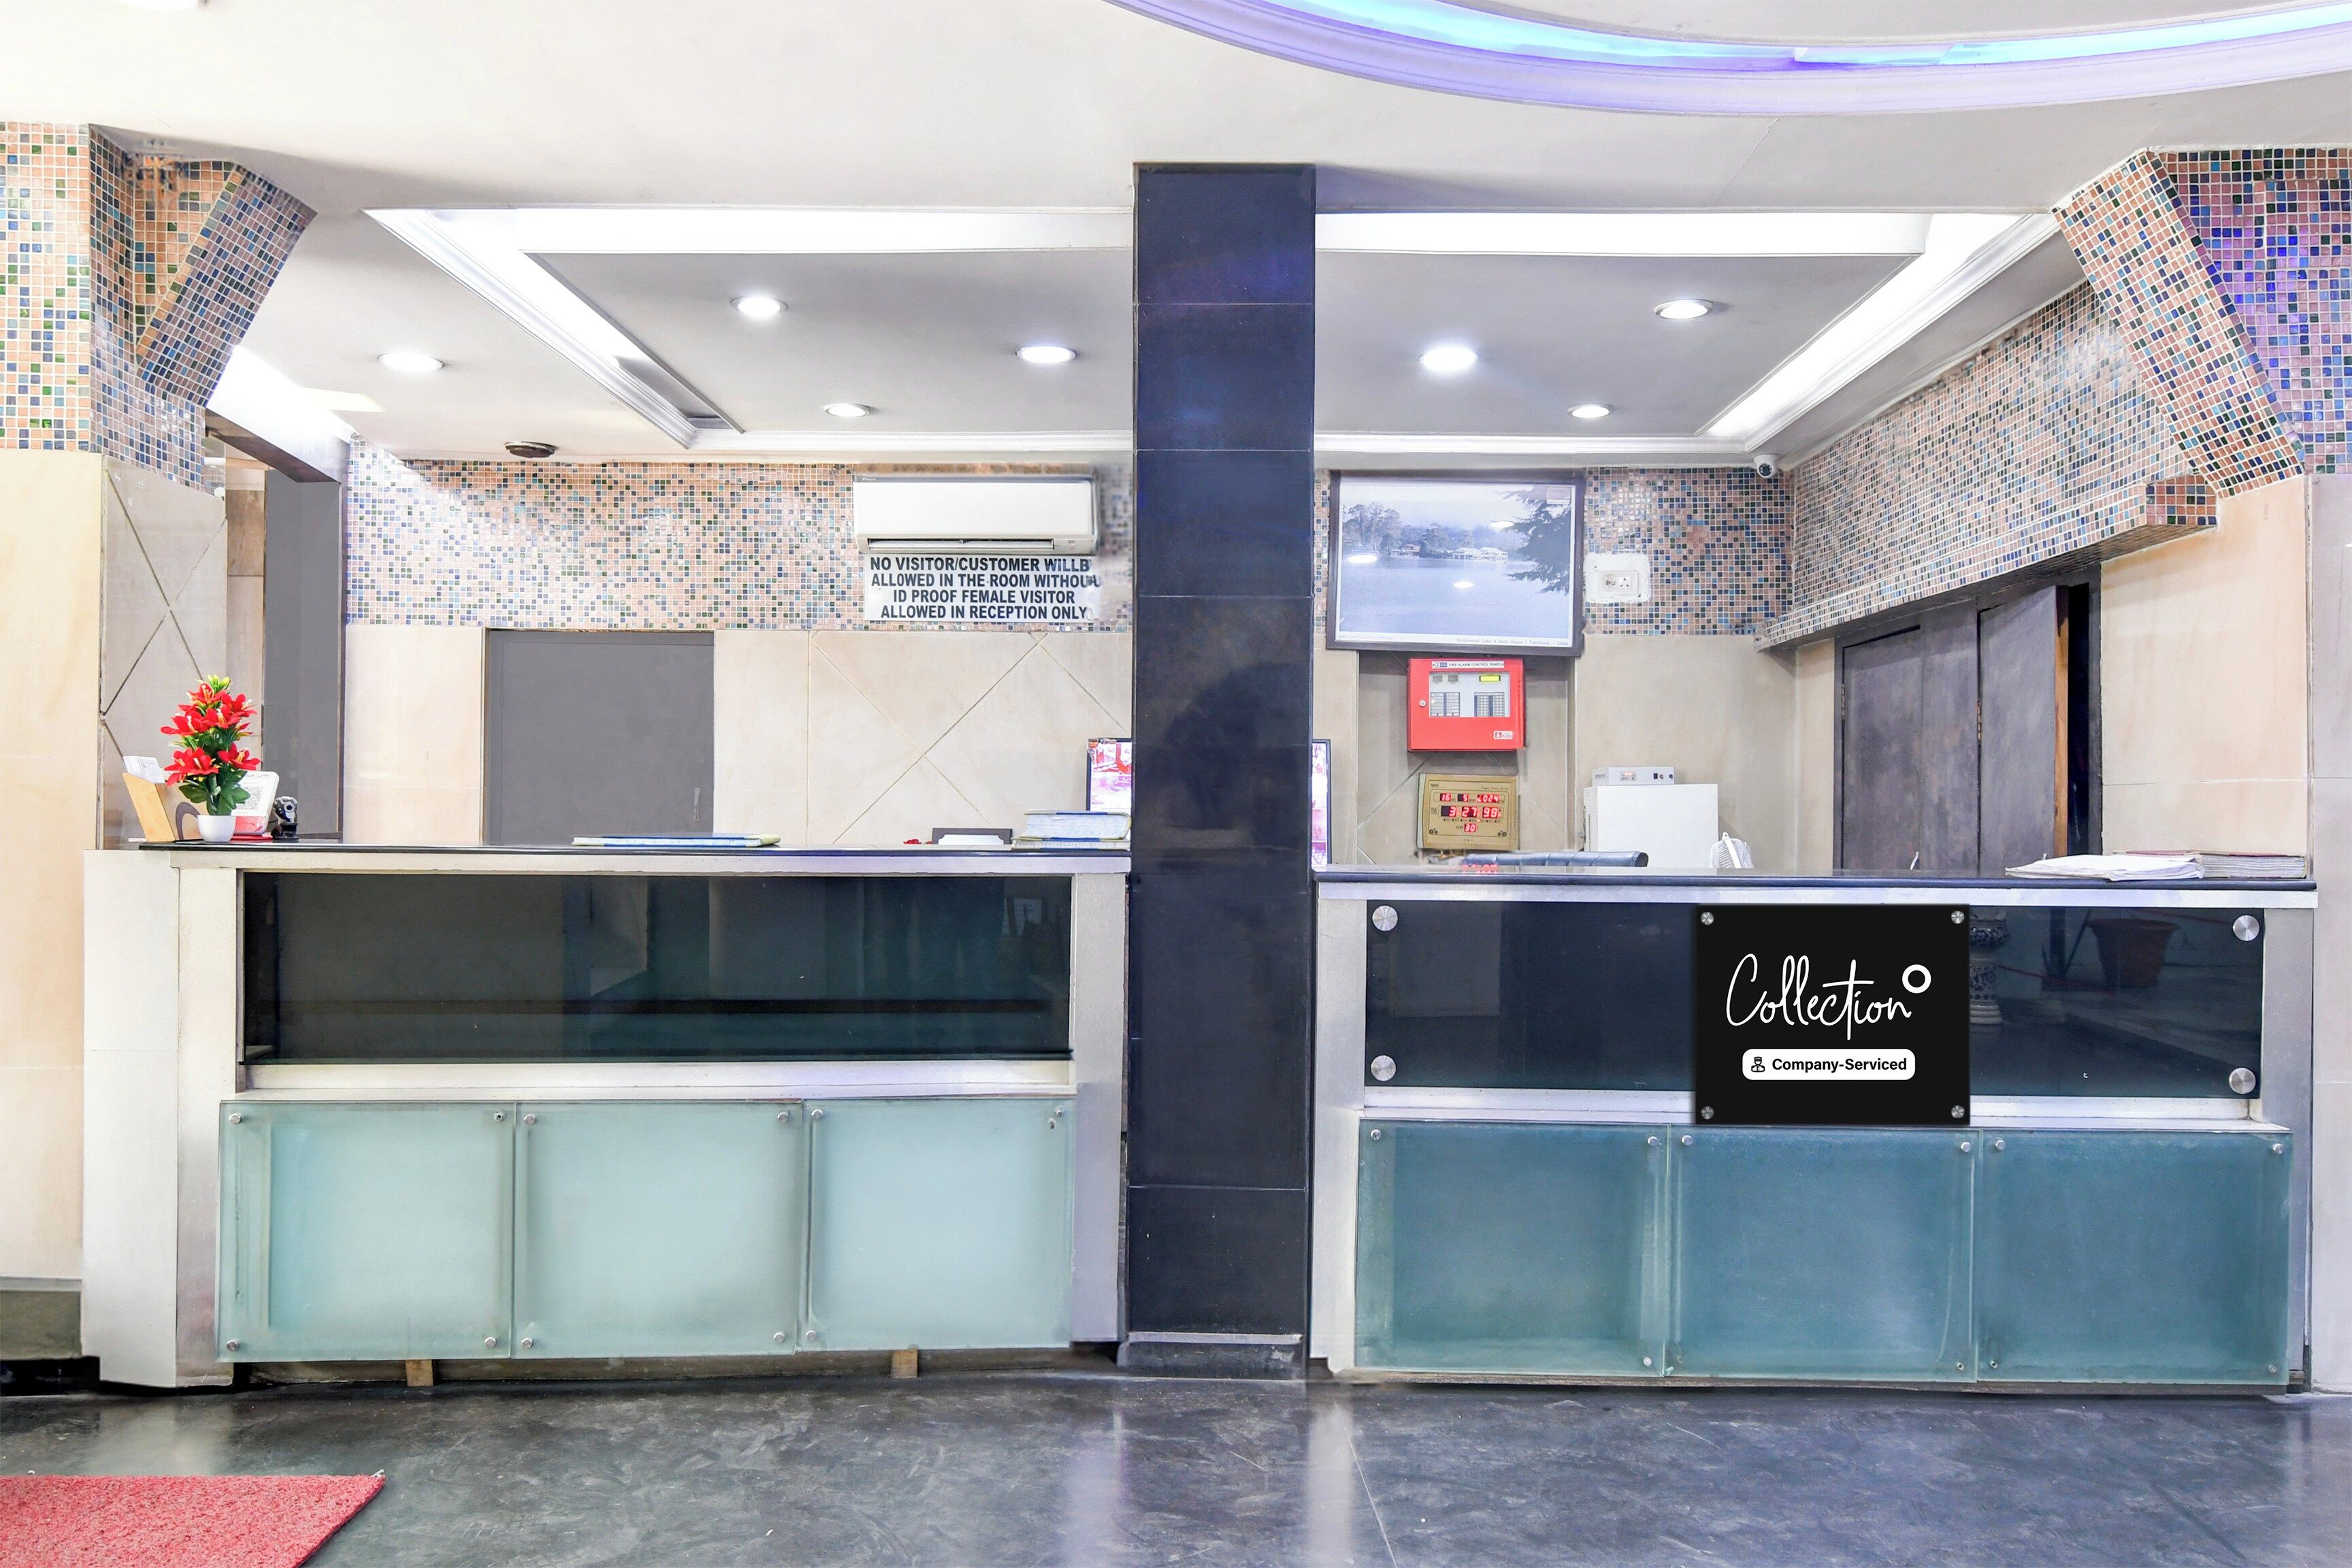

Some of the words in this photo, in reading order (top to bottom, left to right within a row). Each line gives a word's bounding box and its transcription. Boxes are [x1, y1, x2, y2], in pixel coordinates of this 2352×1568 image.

[870, 557, 891, 570] NO
[896, 557, 1040, 571] VISITOR/CUSTOMER
[1045, 558, 1092, 572] WILLB
[871, 573, 934, 587] ALLOWED
[940, 574, 953, 587] IN
[958, 574, 985, 587] THE
[990, 574, 1030, 587] ROOM
[894, 589, 906, 602] ID
[912, 589, 957, 603] PROOF
[962, 590, 1015, 603] FEMALE
[1020, 590, 1075, 604] VISITOR
[881, 605, 946, 618] ALLOWED
[951, 606, 964, 618] IN
[970, 606, 1047, 619] RECEPTION
[1051, 606, 1088, 619] ONLY
[1465, 823, 1475, 832] 30
[1726, 953, 1912, 1041] Collection
[1771, 1058, 1907, 1073] Company-Serviced
